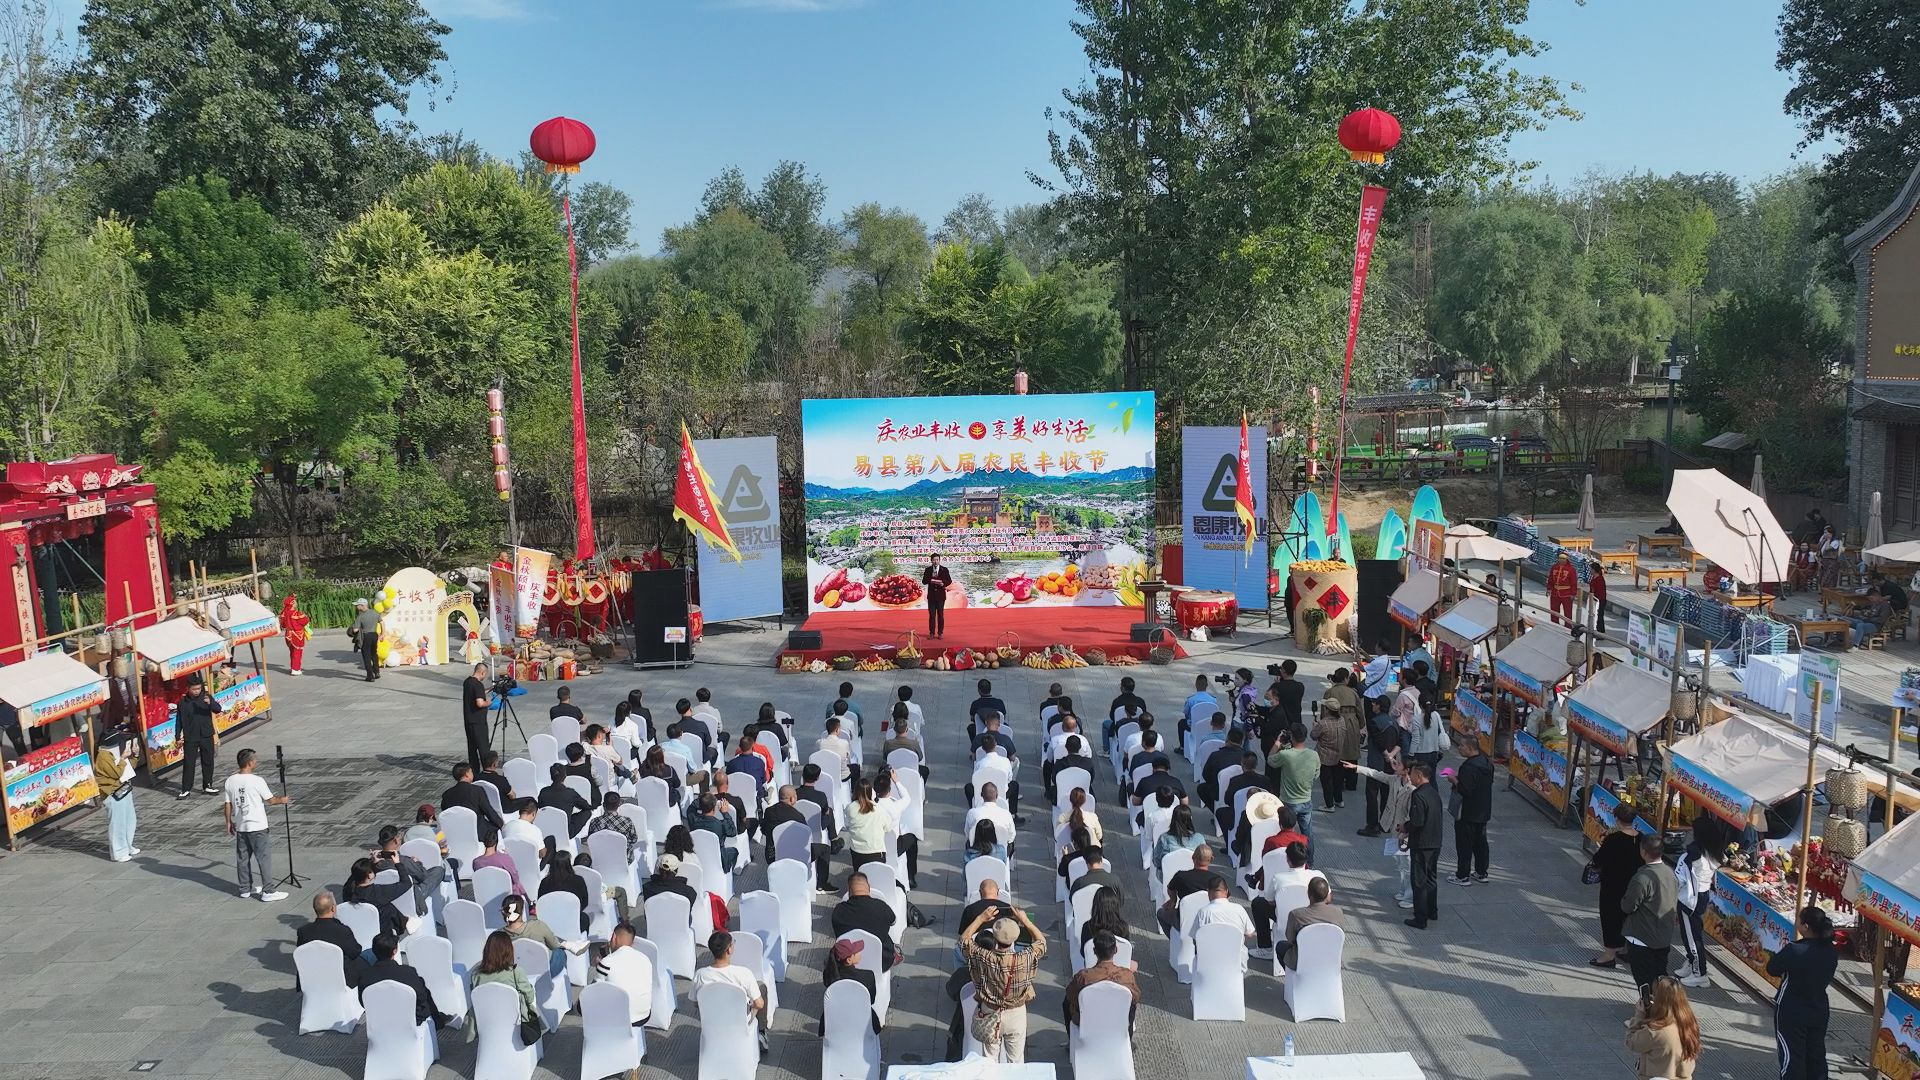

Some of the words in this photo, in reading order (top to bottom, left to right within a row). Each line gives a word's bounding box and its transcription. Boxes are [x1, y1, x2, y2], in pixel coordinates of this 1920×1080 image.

[876, 417, 965, 444] 庆农业丰收
[992, 415, 1089, 443] 享美好生活
[854, 450, 1107, 478] 易县第八届农民丰收节
[727, 524, 780, 546] 康牧业
[516, 556, 531, 593] 金秋硕果
[528, 582, 541, 610] 庆丰收
[1868, 890, 1920, 933] 易县第八届
